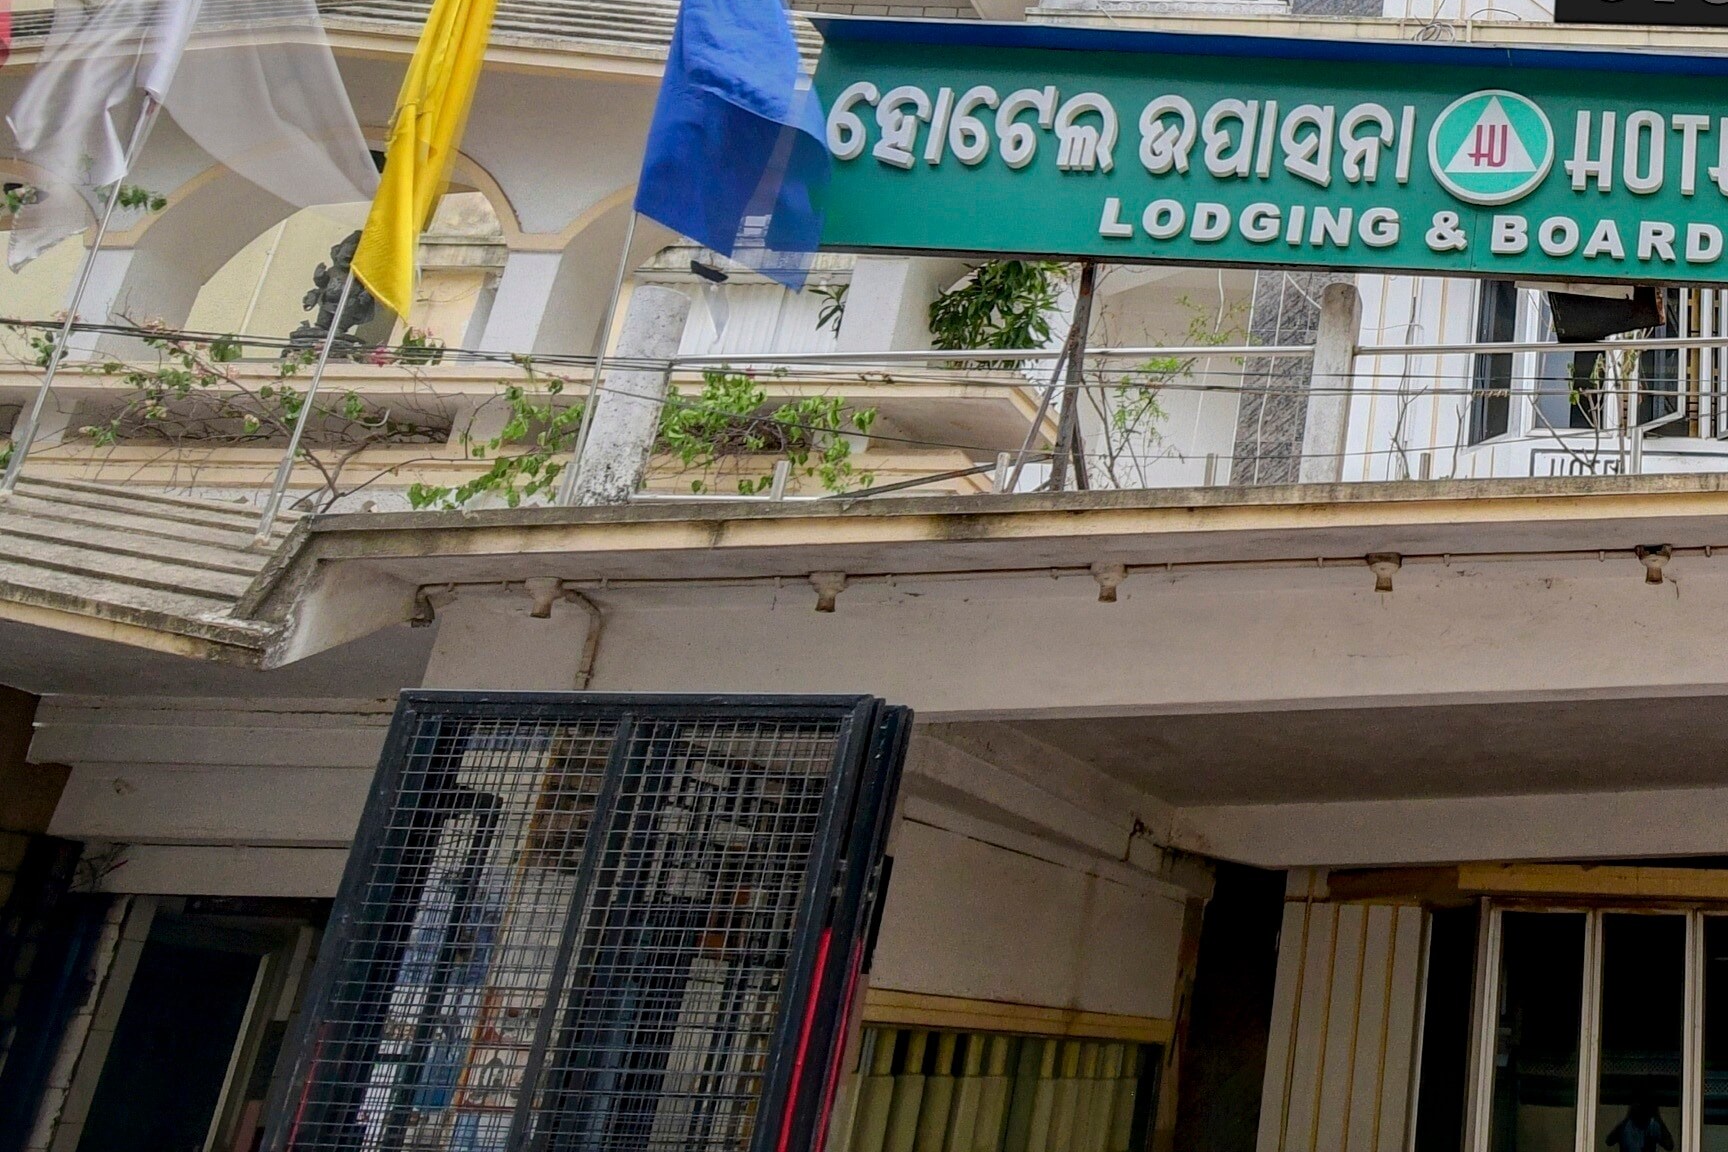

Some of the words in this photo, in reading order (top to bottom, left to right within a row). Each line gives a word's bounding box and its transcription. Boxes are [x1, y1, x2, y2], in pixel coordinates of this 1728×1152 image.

[826, 81, 1118, 173] ହୋଟେଲ
[1139, 95, 1415, 188] ଉପାସନା
[1099, 197, 1400, 247] LODGING
[1425, 211, 1468, 251] &
